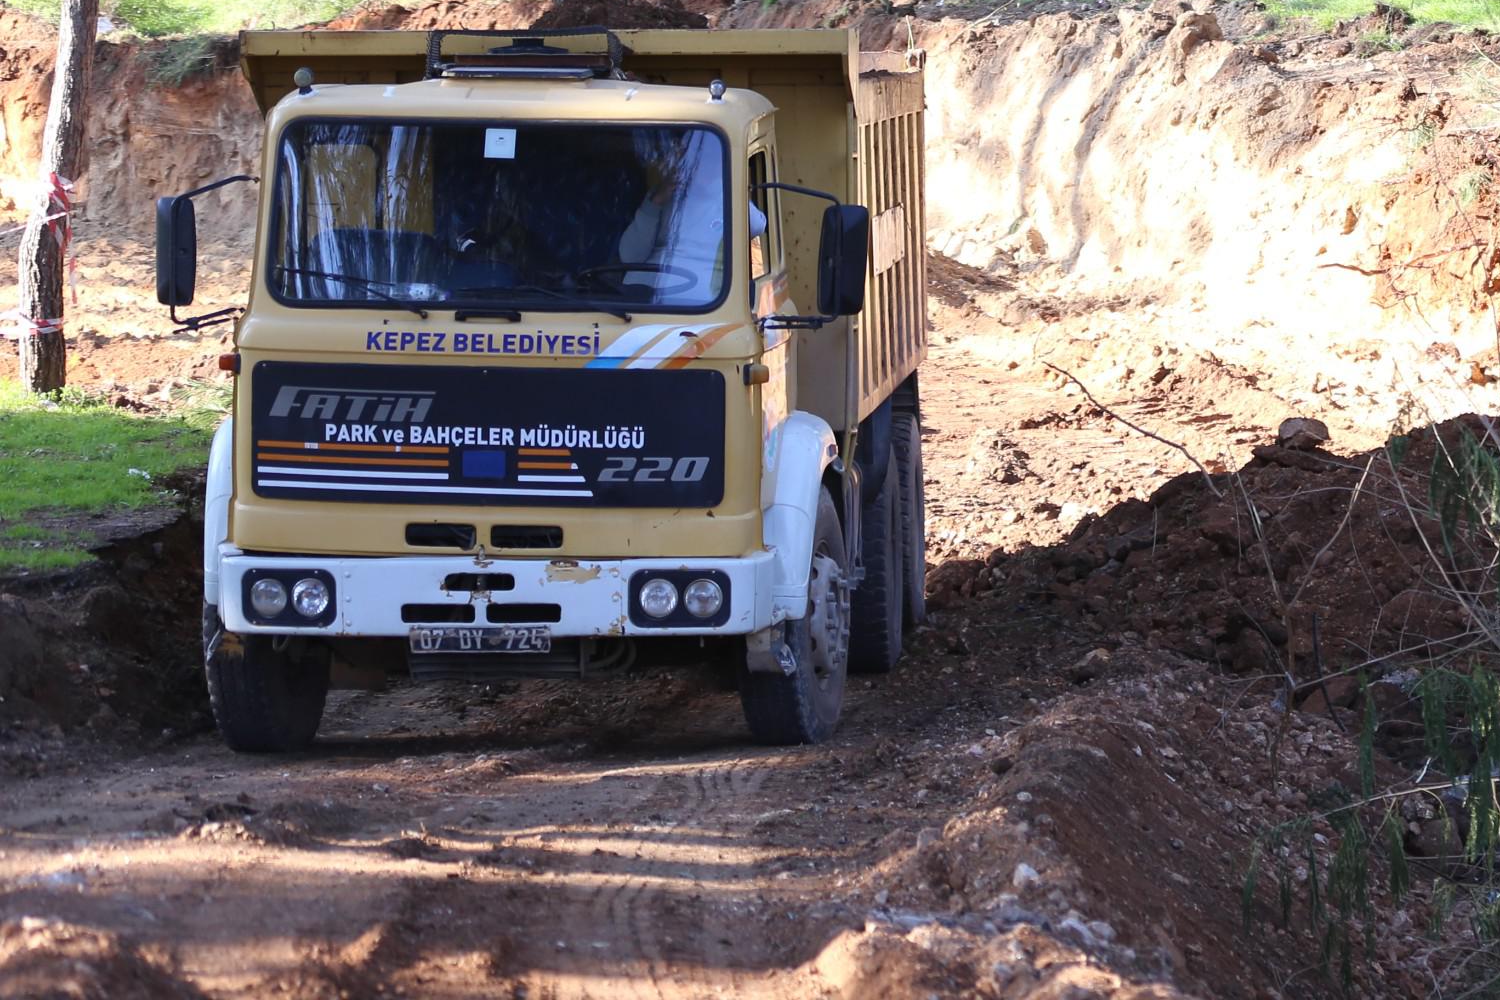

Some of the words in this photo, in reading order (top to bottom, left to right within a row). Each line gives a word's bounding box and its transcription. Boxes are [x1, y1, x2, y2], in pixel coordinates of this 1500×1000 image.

[366, 331, 447, 352] KEPEZ
[453, 330, 600, 355] BELEDİYESİ
[325, 423, 378, 443] PARK
[382, 428, 404, 443] ve
[410, 425, 514, 447] BAHÇELER
[520, 424, 645, 449] MÜDÜRLÜĞÜ
[597, 456, 710, 482] 220
[420, 629, 444, 650] 07
[460, 629, 483, 650] DY
[504, 628, 542, 649] 724
